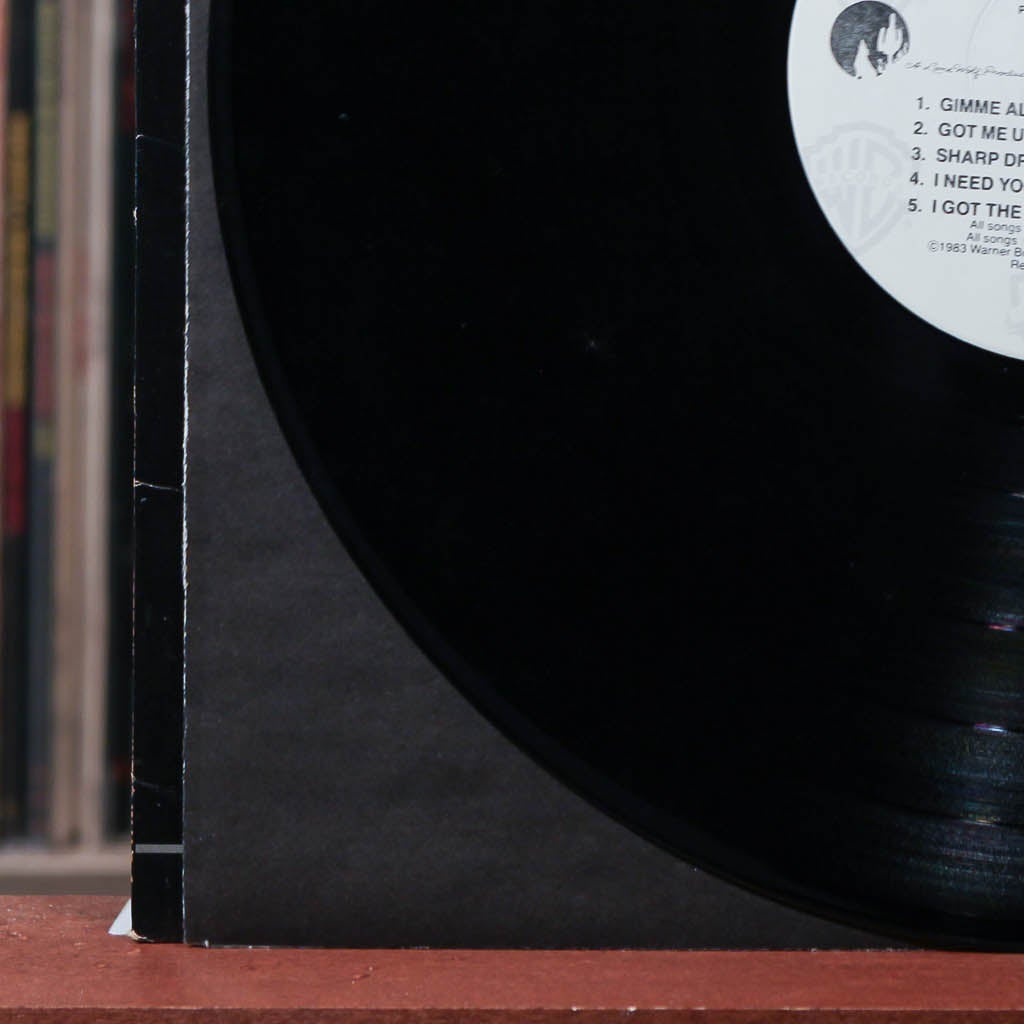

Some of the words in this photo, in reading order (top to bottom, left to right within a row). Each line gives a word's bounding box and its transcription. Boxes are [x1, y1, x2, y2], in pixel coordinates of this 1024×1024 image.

[917, 97, 930, 110] 1.
[940, 97, 1001, 115] GIMME
[913, 121, 928, 135] 2.
[938, 122, 977, 138] GOT
[981, 125, 1008, 141] ME
[911, 146, 926, 161] 3.
[936, 147, 999, 166] SHARP
[909, 171, 924, 186] 4.
[934, 173, 939, 187] I
[944, 174, 994, 190] NEED
[908, 198, 922, 212] 5.
[932, 199, 937, 213] I
[942, 200, 981, 216] GOT
[986, 203, 1022, 219] THE
[970, 220, 984, 230] All
[987, 222, 1021, 234] songs
[966, 232, 980, 242] All
[970, 244, 1010, 257] Warner
